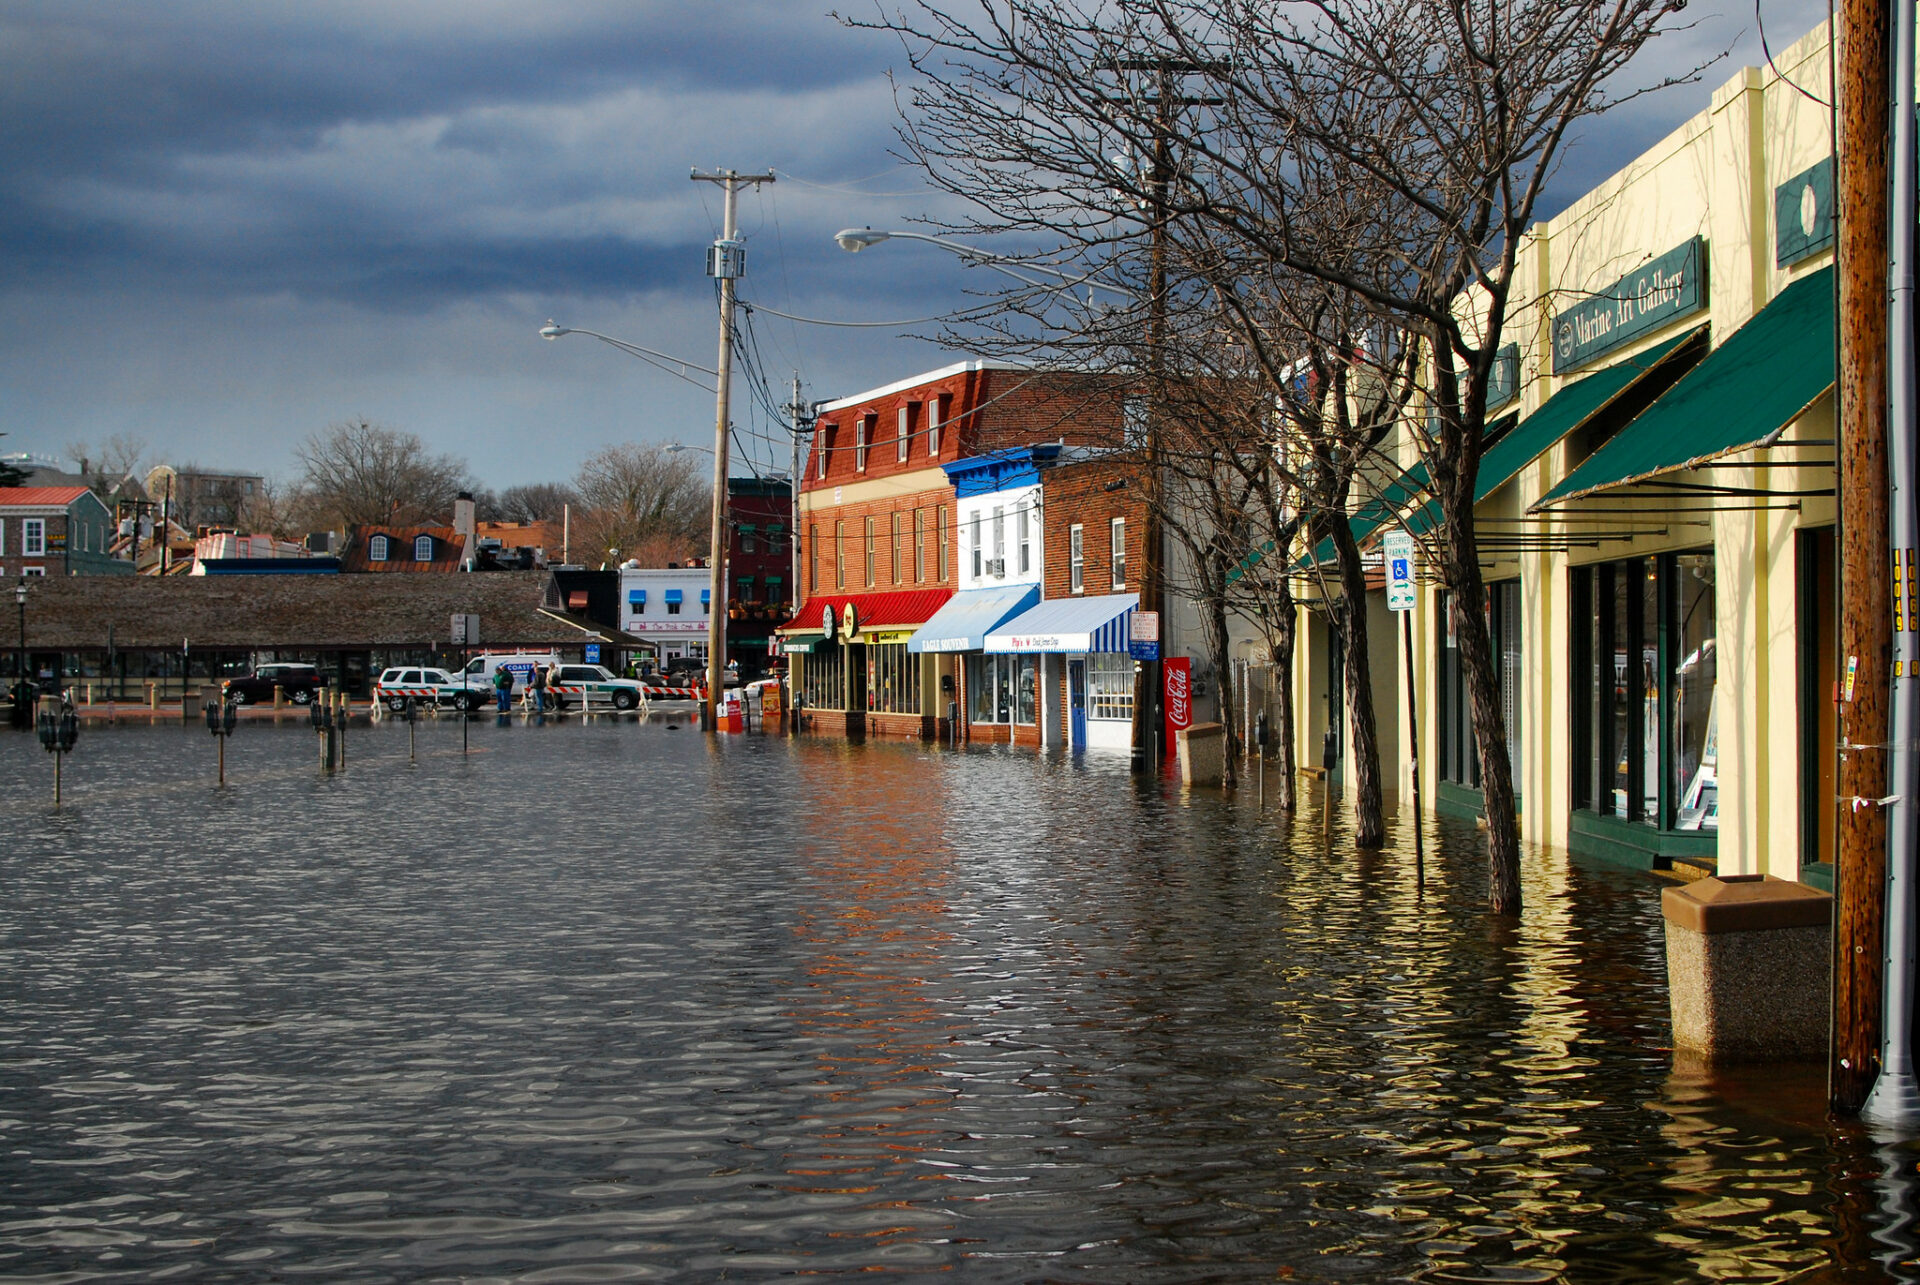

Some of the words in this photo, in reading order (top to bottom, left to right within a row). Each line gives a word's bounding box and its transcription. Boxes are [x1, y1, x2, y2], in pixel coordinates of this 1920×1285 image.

[1574, 308, 1612, 347] Marine
[1616, 291, 1634, 327] Art
[1637, 269, 1684, 315] Gallery
[1386, 536, 1411, 545] RESERVED
[1894, 549, 1903, 631] 10049
[1908, 549, 1917, 631] 10066
[922, 639, 940, 652] EAGLE
